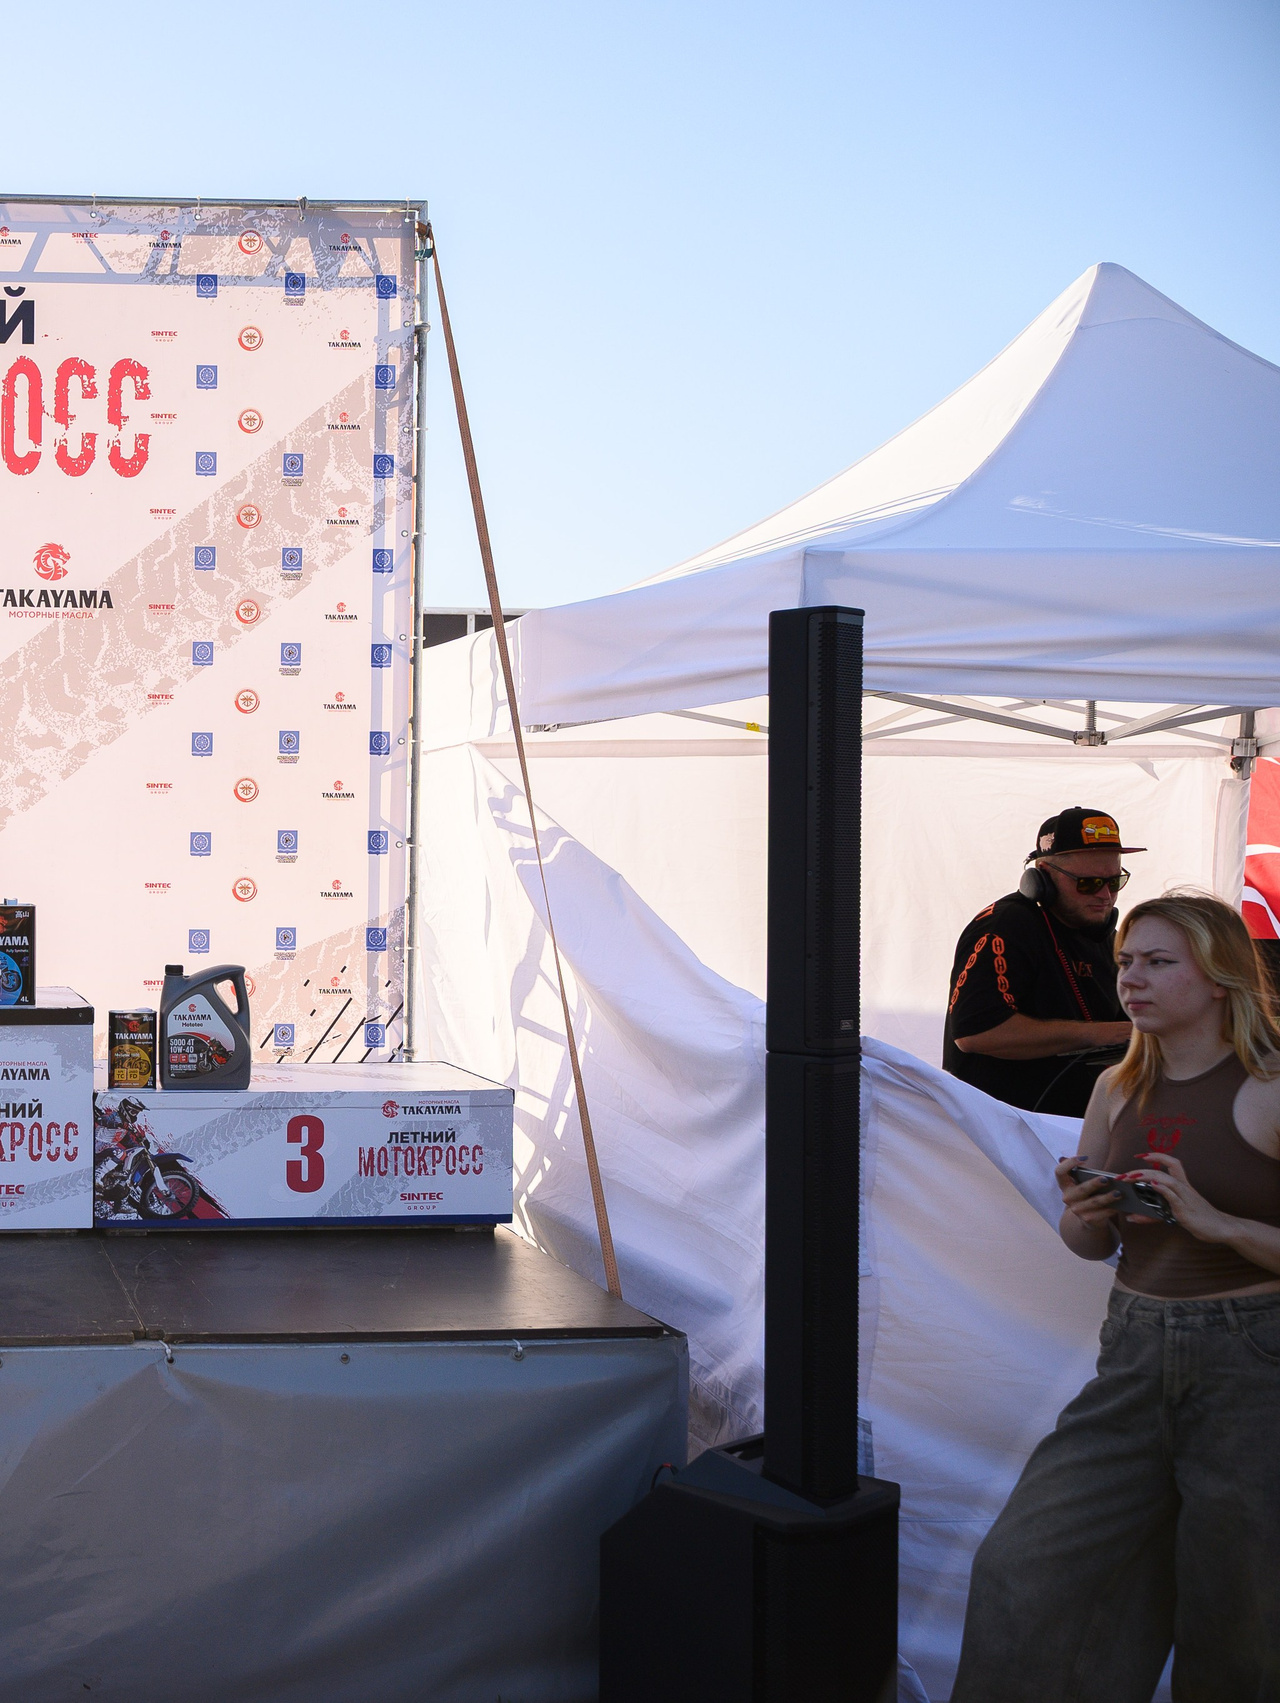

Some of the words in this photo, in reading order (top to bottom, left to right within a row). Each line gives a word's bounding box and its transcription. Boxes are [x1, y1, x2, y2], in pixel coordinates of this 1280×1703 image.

[8, 611, 60, 619] МОТОРНЫЕ
[62, 611, 94, 619] МАСЛА
[402, 1105, 461, 1115] TAKAYAMA
[387, 1128, 456, 1143] ЛЕТНИЙ
[286, 1114, 325, 1193] 3
[358, 1145, 484, 1177] МОТОКРОСС
[400, 1192, 444, 1201] SINTEC
